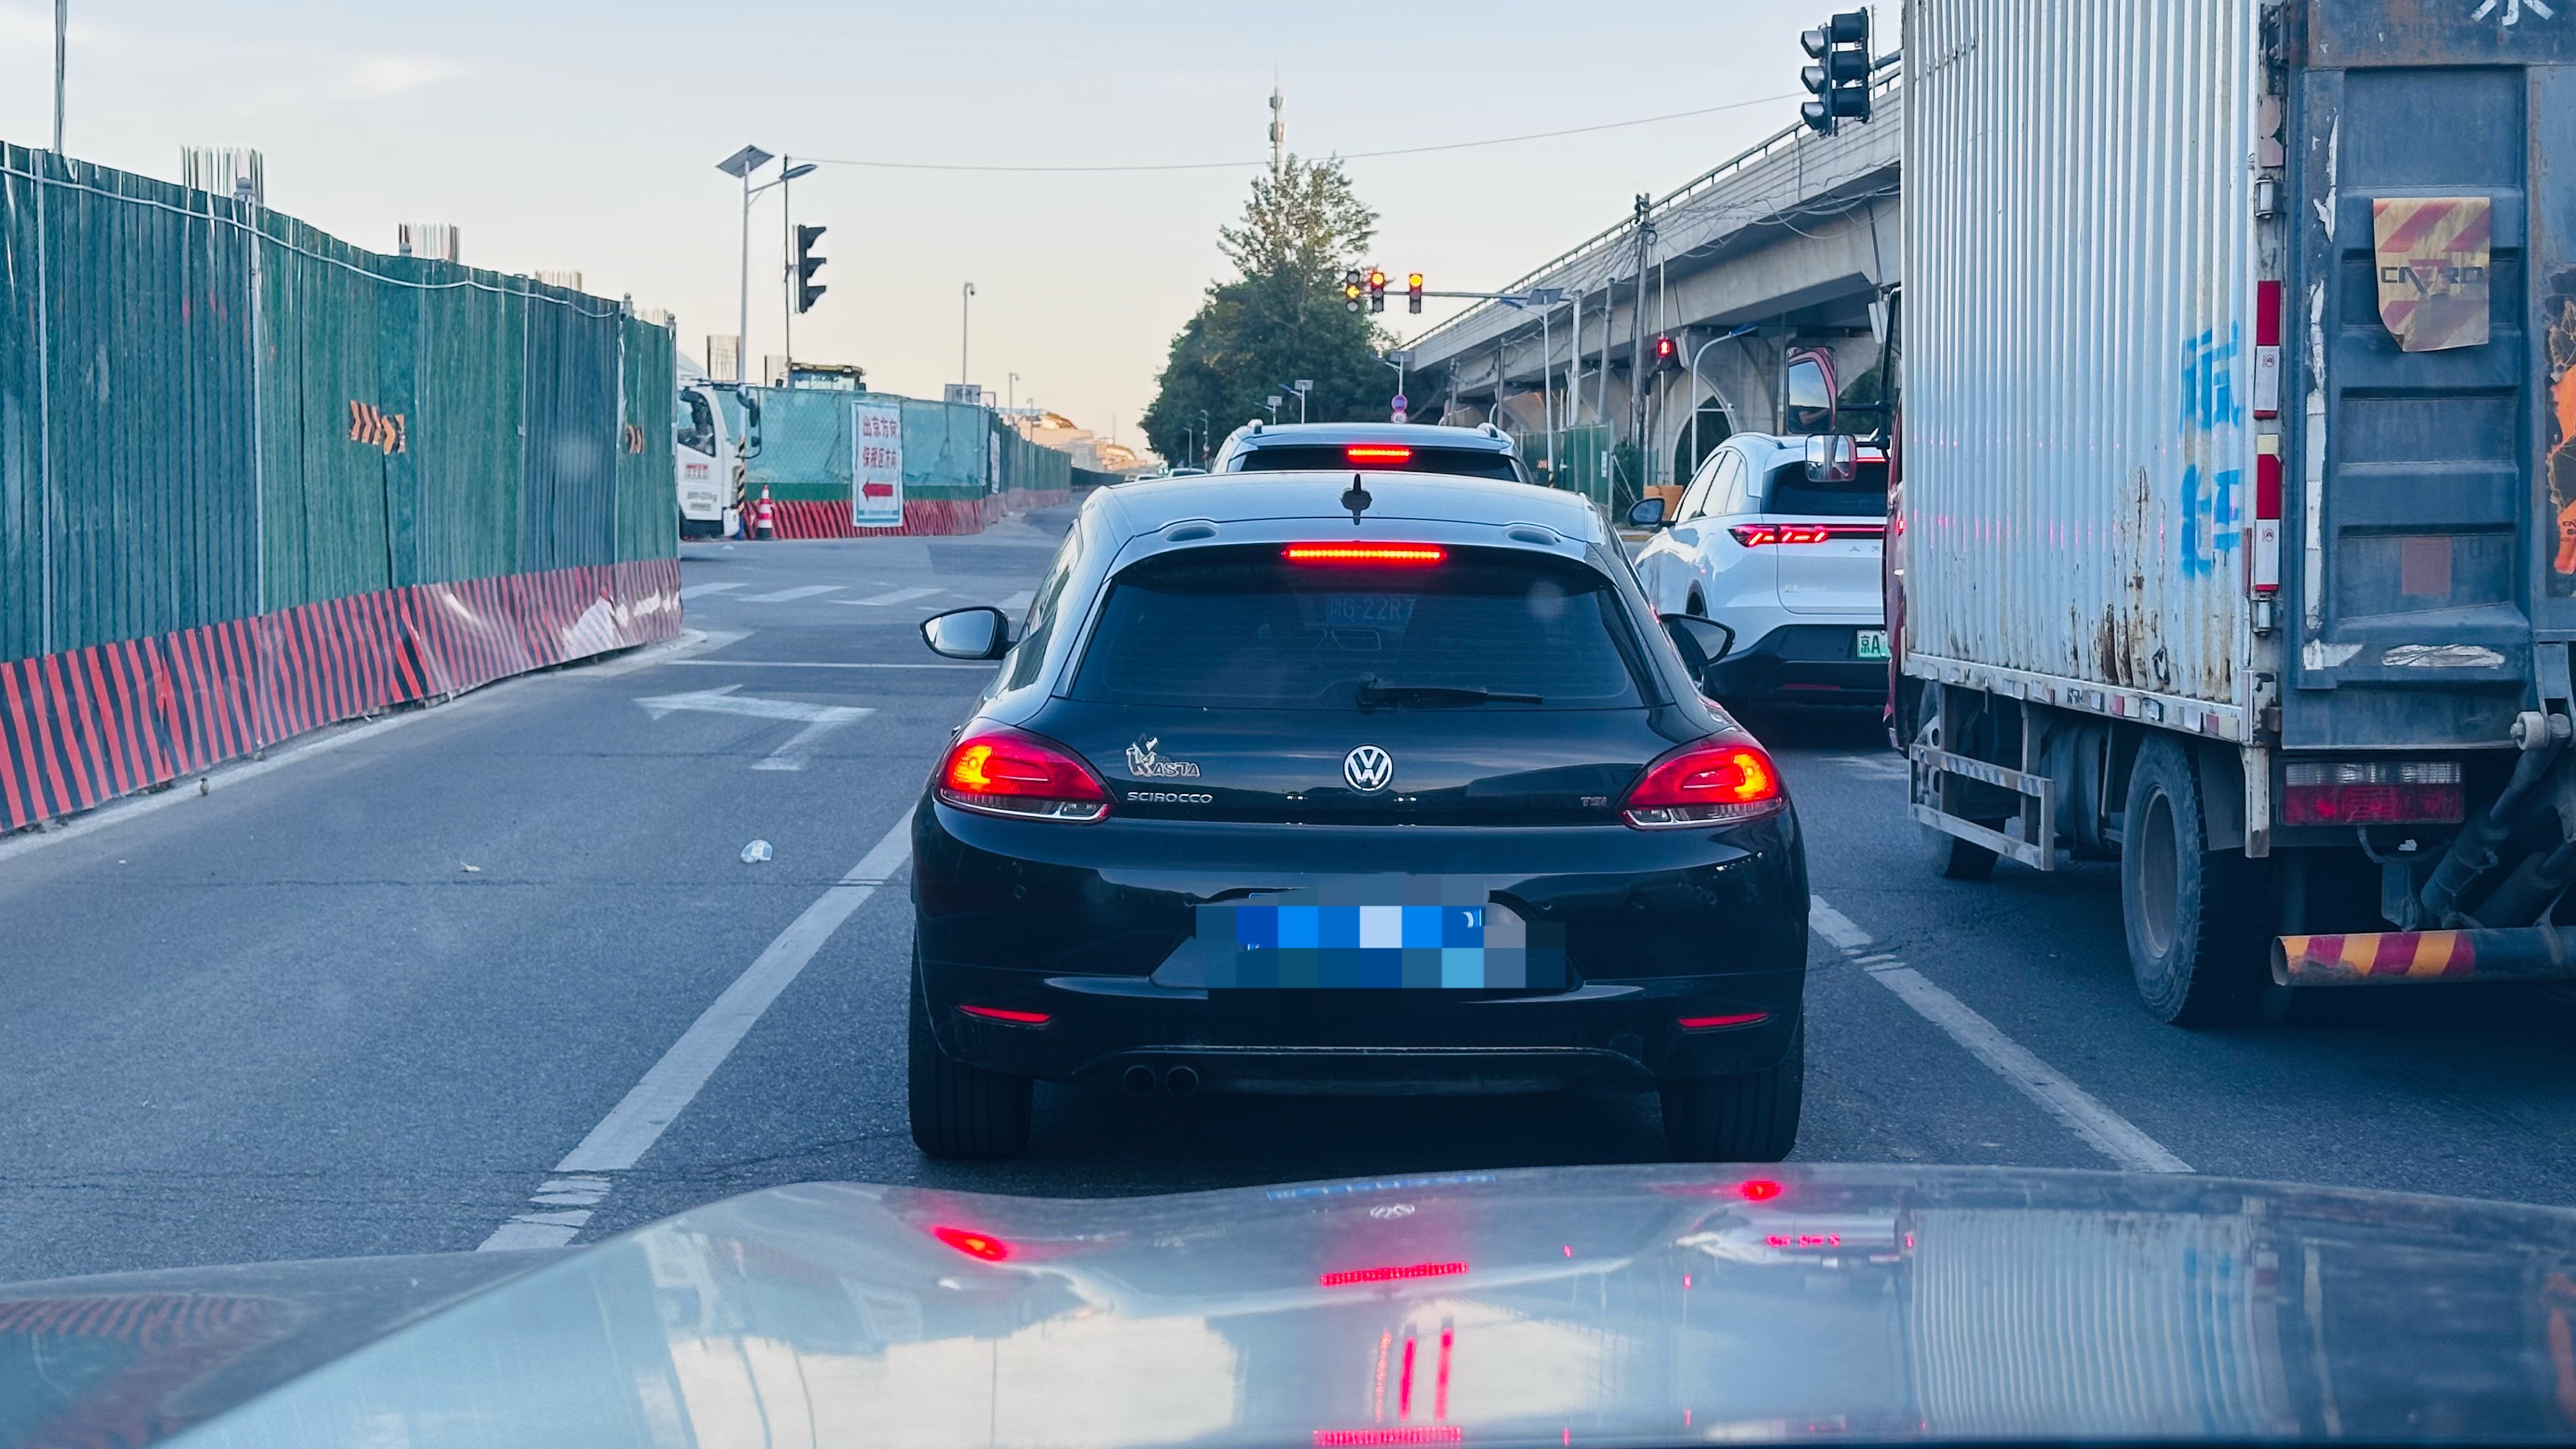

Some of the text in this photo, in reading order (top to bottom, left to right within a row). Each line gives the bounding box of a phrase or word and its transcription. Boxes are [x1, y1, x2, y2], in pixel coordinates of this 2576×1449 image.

[862, 415, 896, 438] 出京方向
[1127, 792, 1213, 803] SCIROCCO
